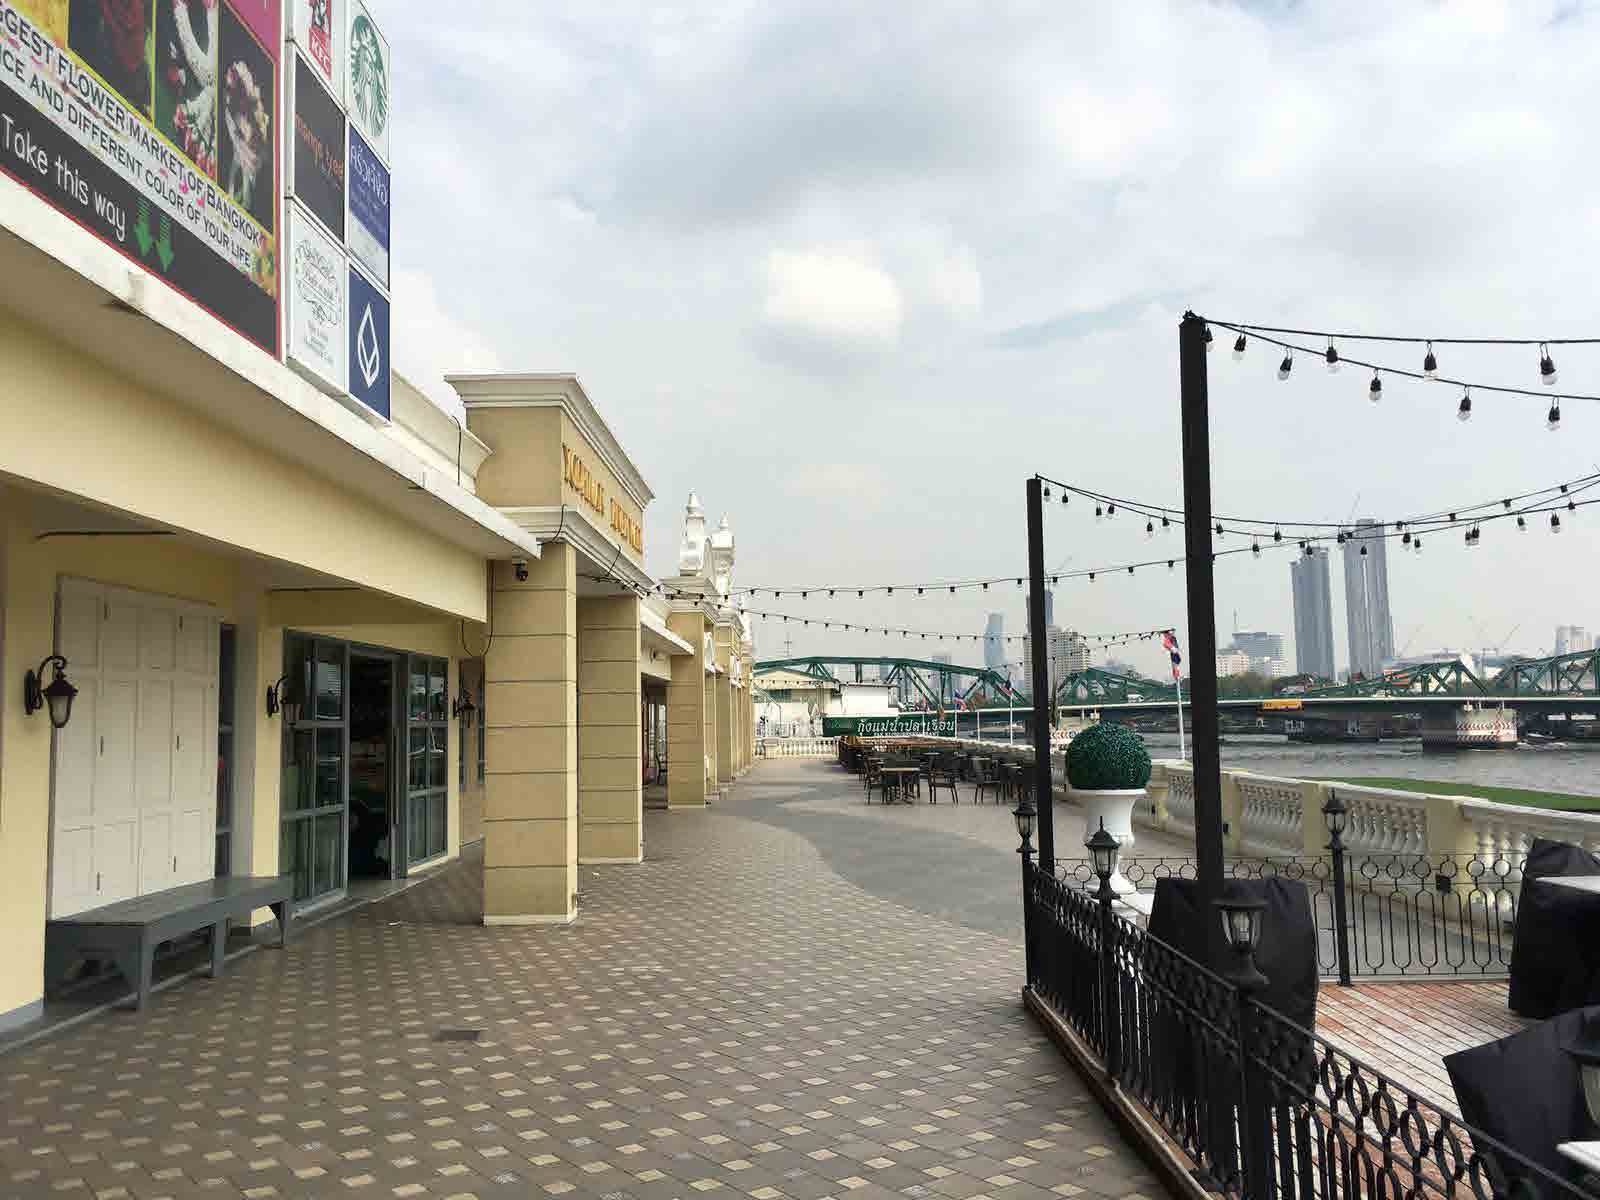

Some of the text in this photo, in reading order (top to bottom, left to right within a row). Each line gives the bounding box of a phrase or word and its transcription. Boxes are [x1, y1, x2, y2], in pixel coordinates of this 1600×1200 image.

[0, 48, 250, 268] CE AND DIFFERENT COLOR OF YOUR LIFE
[2, 112, 126, 242] Take this way
[58, 53, 125, 131] FLOWER
[130, 117, 185, 181] MARKET
[188, 171, 204, 195] OF
[207, 183, 259, 249] BANGKOK
